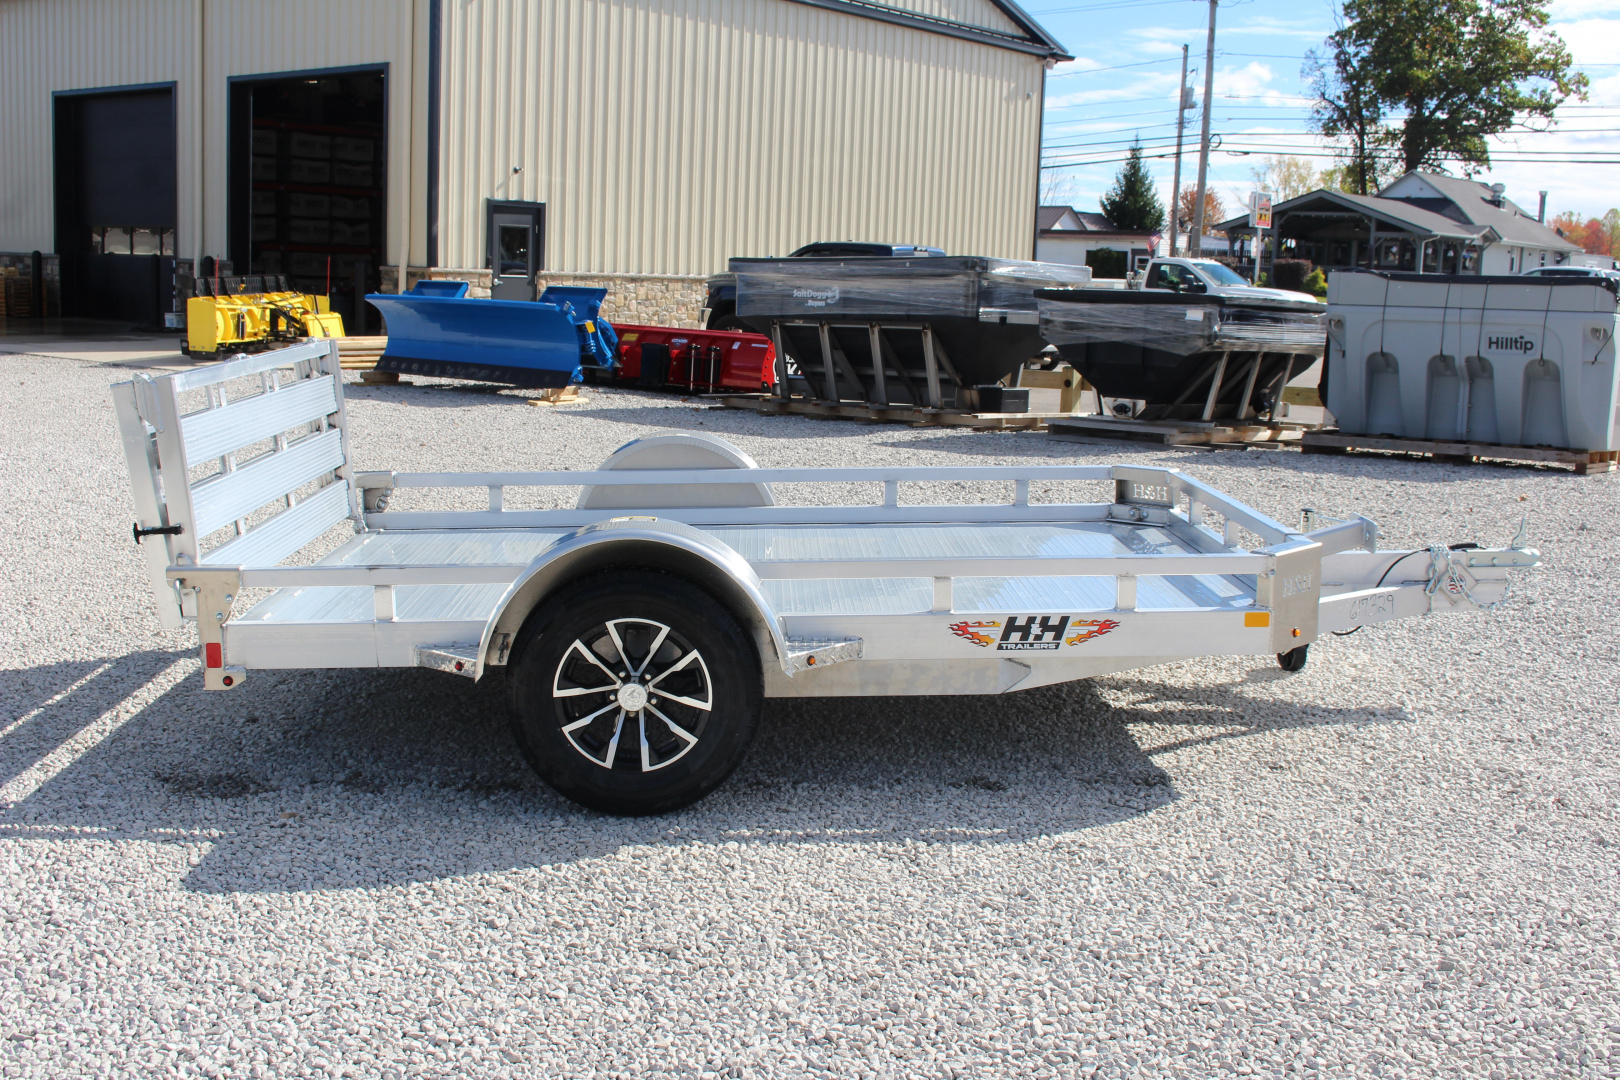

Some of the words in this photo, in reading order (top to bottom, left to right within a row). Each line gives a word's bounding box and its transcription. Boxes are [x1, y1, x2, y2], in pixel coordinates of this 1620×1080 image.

[793, 289, 827, 299] SaltDogg
[1488, 335, 1534, 354] Hilltip
[1000, 616, 1070, 641] H&H
